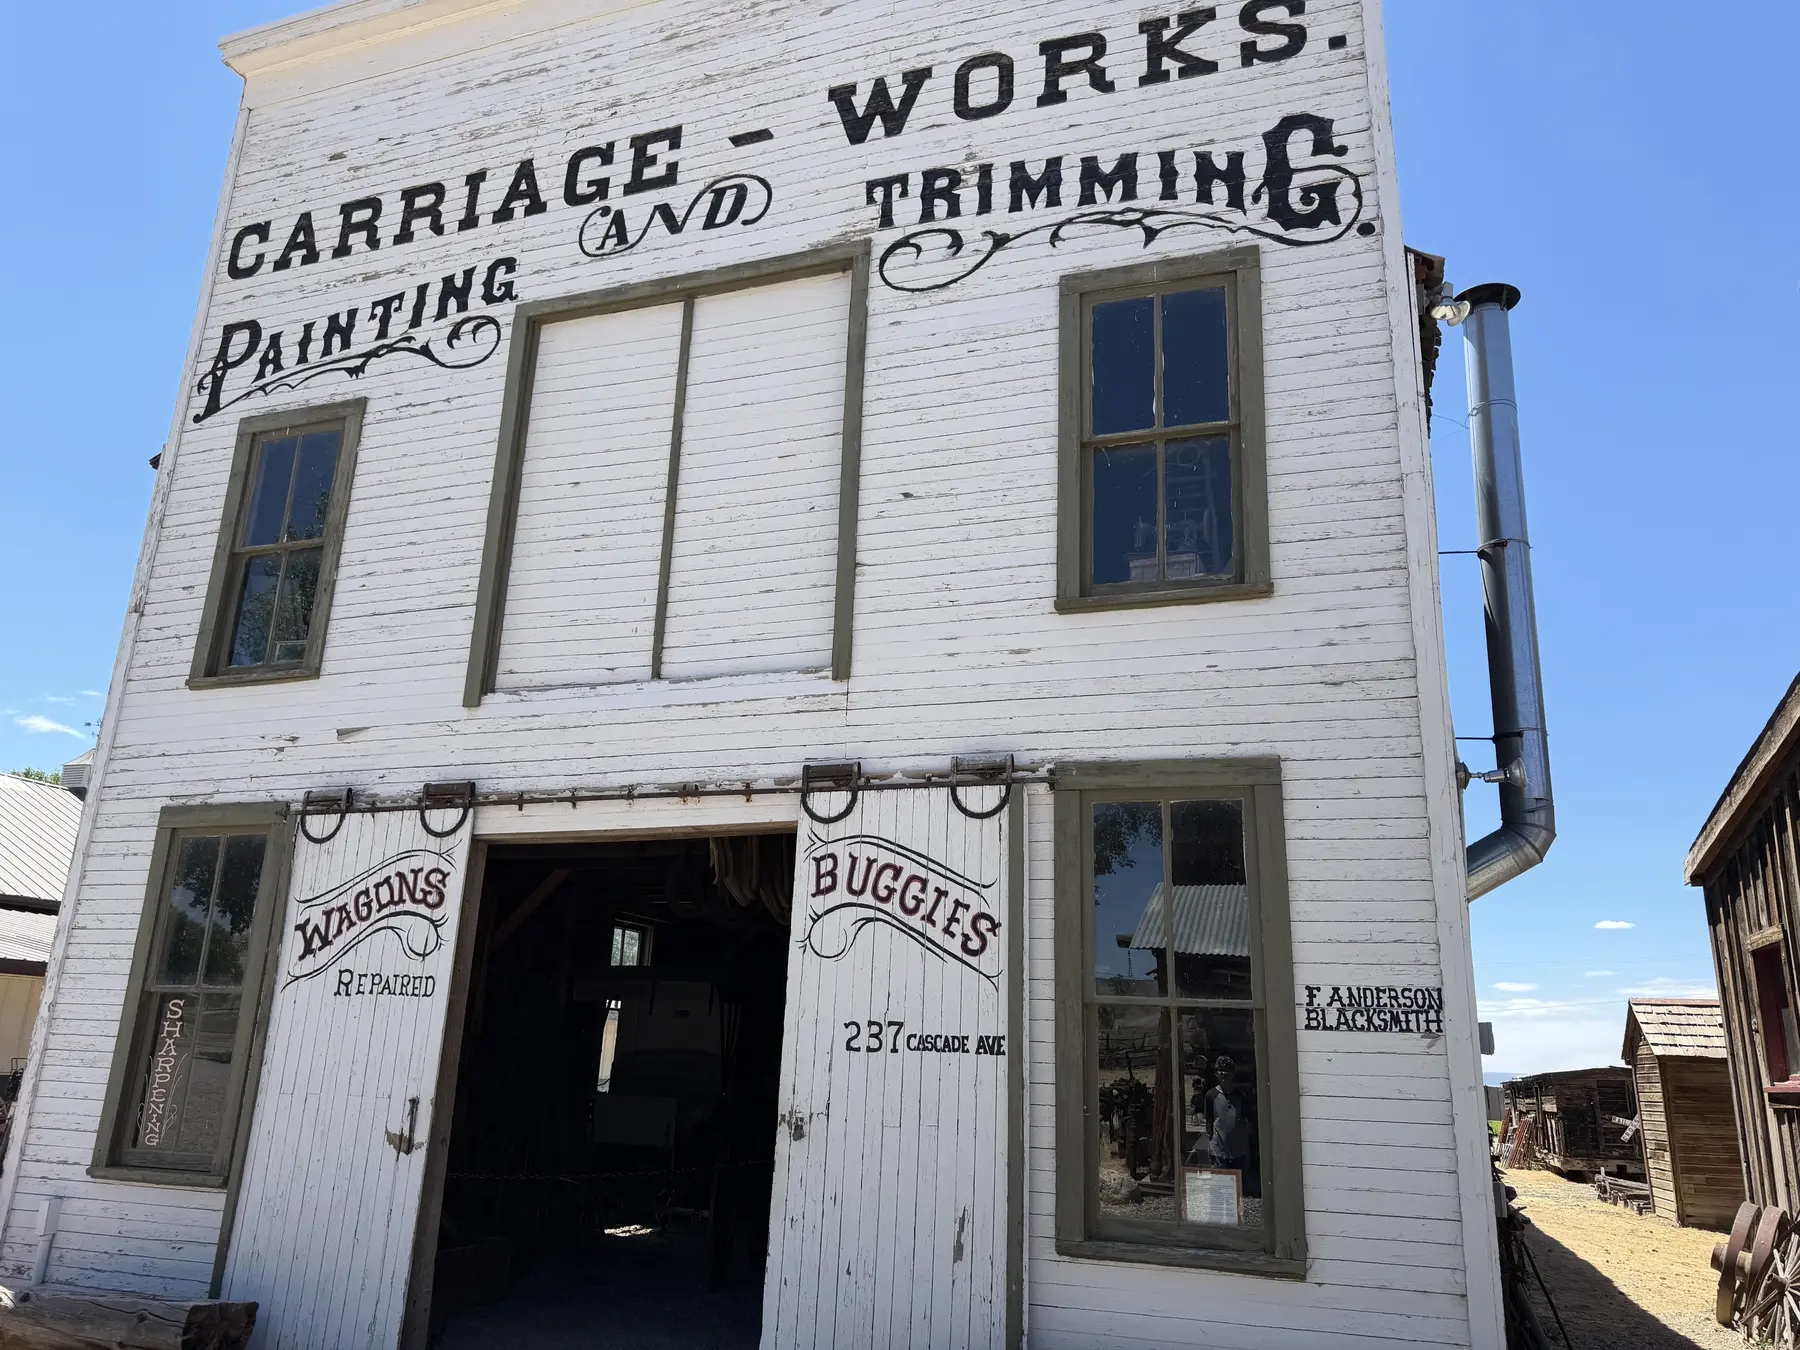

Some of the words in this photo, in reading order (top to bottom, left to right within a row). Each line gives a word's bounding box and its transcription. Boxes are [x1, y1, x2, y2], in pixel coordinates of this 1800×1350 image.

[228, 124, 683, 280] CARRIAGE
[827, 0, 1347, 146] WORKS.
[193, 256, 519, 423] PAINTING
[578, 173, 772, 257] AND
[294, 867, 451, 961] WAGONS
[810, 852, 1002, 957] BUGGIES
[333, 968, 436, 998] REPAIRED
[1304, 985, 1322, 1007] F.
[1326, 986, 1443, 1010] ANDERSON
[843, 1020, 905, 1053] 237
[906, 1033, 970, 1053] CASCADE
[975, 1034, 1006, 1056] AVE
[1304, 1008, 1443, 1033] BLACKSMITH
[145, 999, 185, 1147] SHARPENING
[1622, 1114, 1640, 1141] CROSS
